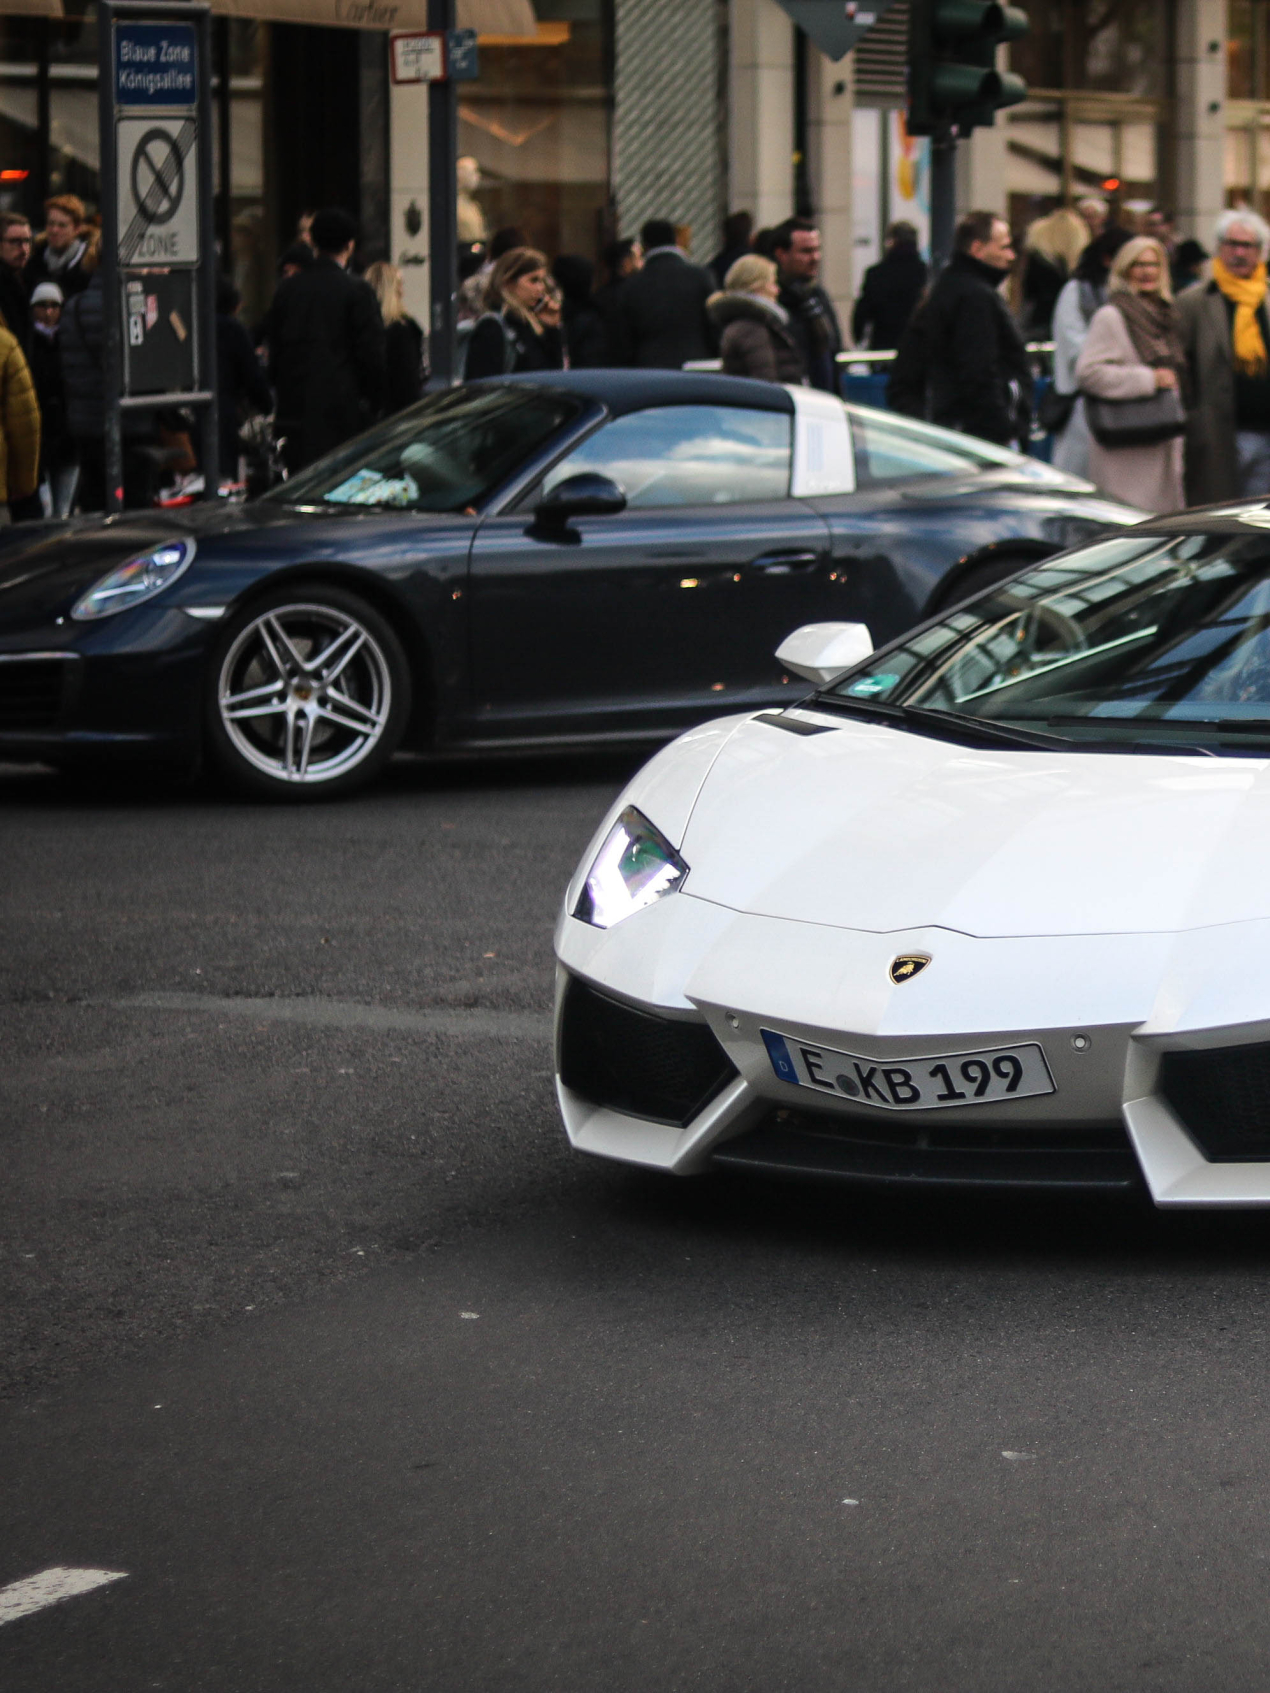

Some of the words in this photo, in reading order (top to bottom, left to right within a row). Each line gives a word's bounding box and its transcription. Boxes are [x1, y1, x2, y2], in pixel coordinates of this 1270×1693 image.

[120, 39, 156, 62] Blaue
[159, 39, 190, 62] Zone
[118, 67, 193, 95] Königsallee
[138, 232, 180, 257] ZONE
[799, 1046, 835, 1089] E
[853, 1062, 921, 1104] KB
[928, 1054, 1023, 1101] 199
